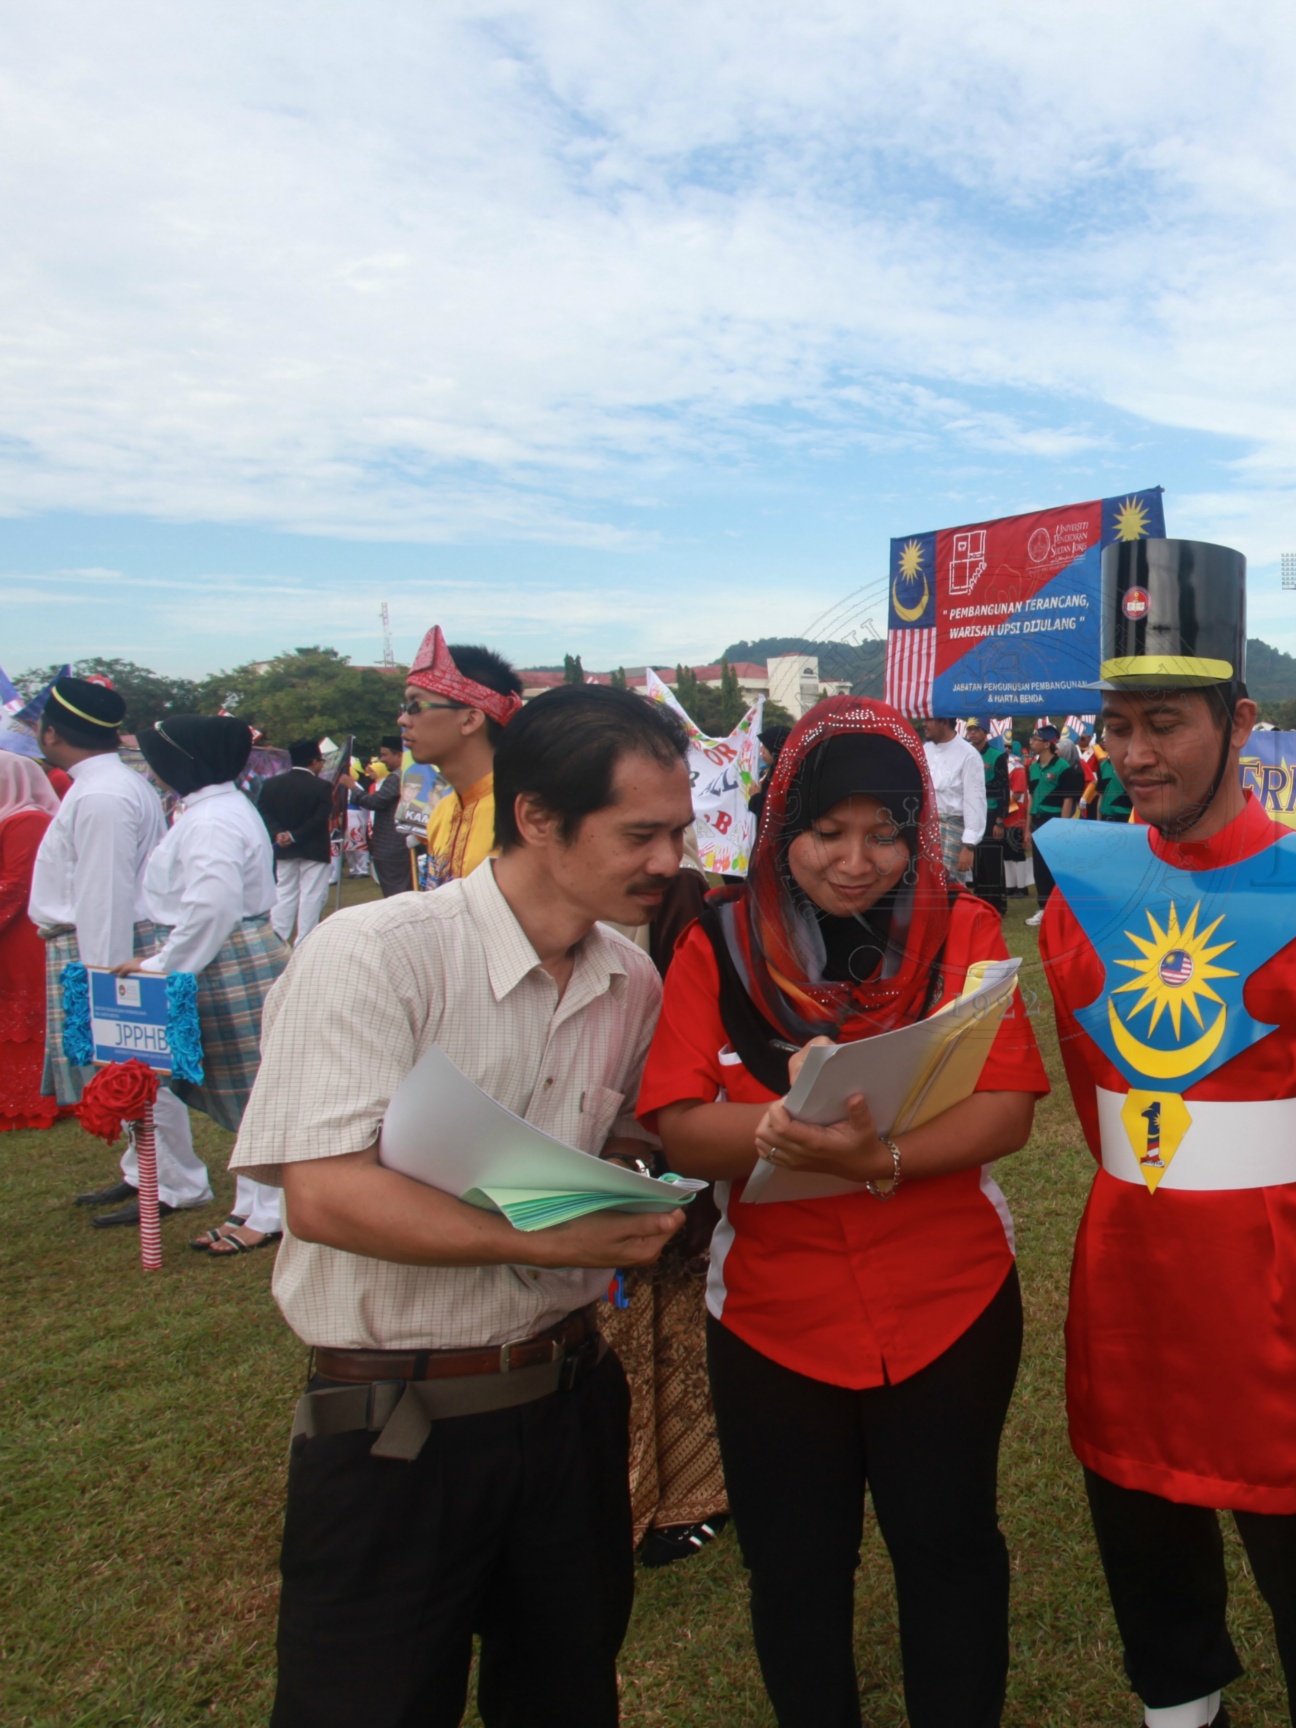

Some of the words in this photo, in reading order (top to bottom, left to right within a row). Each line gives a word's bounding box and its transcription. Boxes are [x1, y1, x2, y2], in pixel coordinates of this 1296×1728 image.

[949, 626, 995, 640] WARISAN
[997, 621, 1021, 637] UPSI
[1023, 616, 1077, 633] DIJULANG
[952, 683, 983, 692] JABATAN
[984, 683, 1030, 692] PENGURUSAN
[987, 694, 994, 703] &
[994, 694, 1019, 704] HARTA
[1020, 694, 1044, 704] BENDA
[115, 1023, 169, 1051] JPPHB
